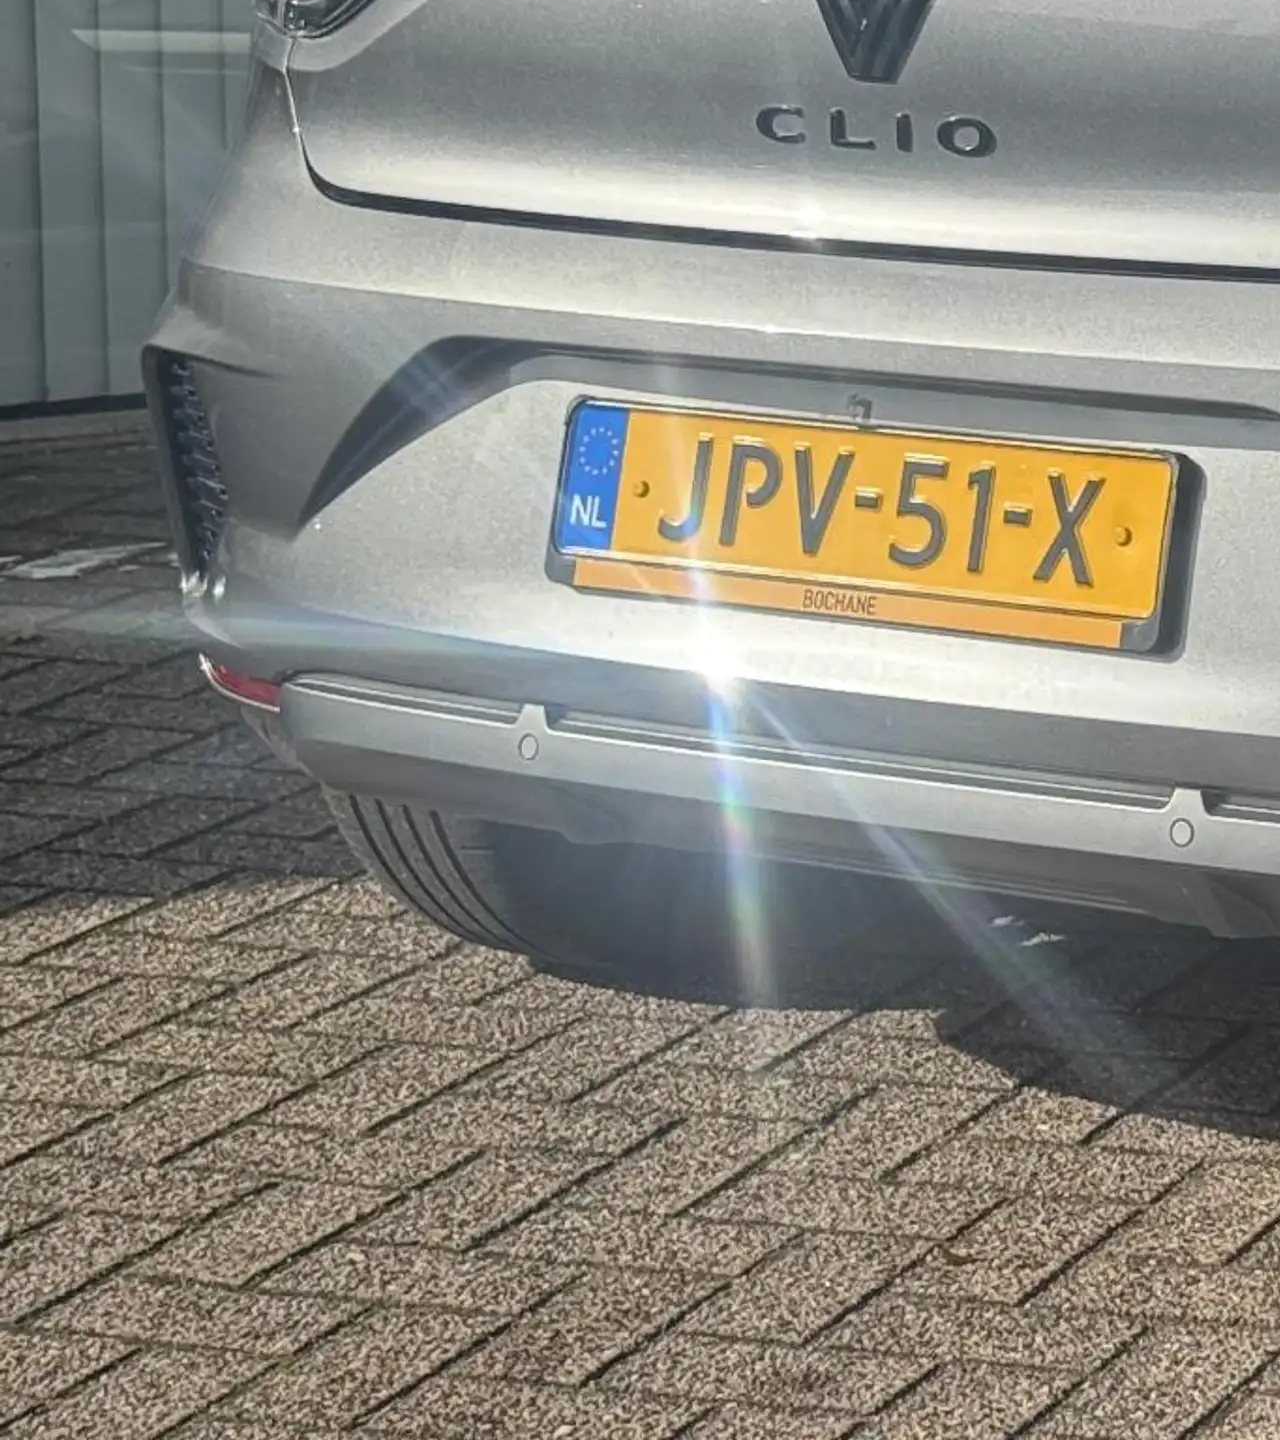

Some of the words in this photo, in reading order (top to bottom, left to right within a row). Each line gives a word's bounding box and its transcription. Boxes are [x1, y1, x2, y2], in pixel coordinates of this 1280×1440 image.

[755, 103, 998, 159] CLIO
[570, 493, 608, 531] NL
[657, 432, 1106, 588] JPV-51-X
[802, 588, 878, 617] BOCHANE
